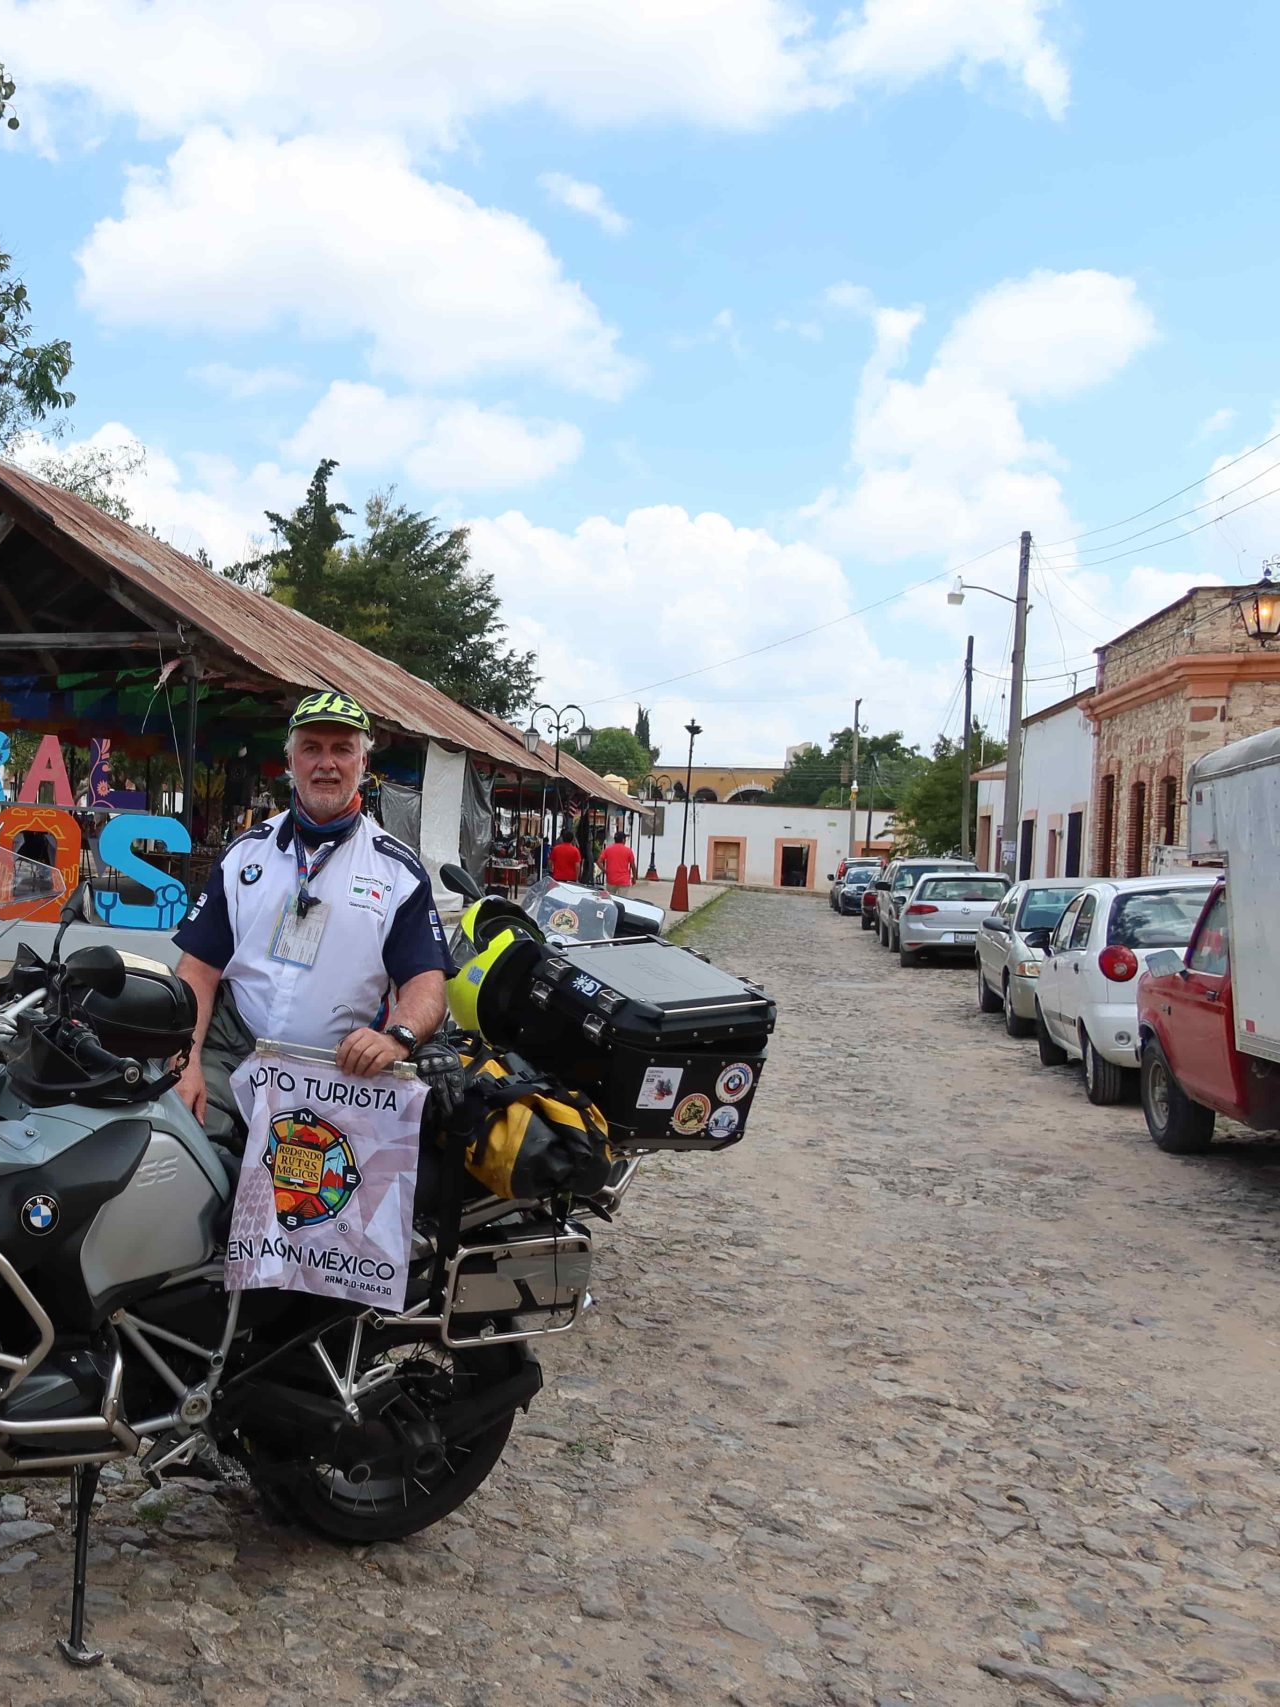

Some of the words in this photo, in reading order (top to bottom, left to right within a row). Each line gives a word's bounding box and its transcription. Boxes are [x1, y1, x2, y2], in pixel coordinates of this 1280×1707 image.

[303, 1077, 398, 1112] TURISTA
[299, 1112, 313, 1123] N
[346, 1173, 357, 1184] E
[286, 1216, 298, 1226] S
[228, 1238, 254, 1261] EN
[308, 1247, 396, 1281] MÉXICO
